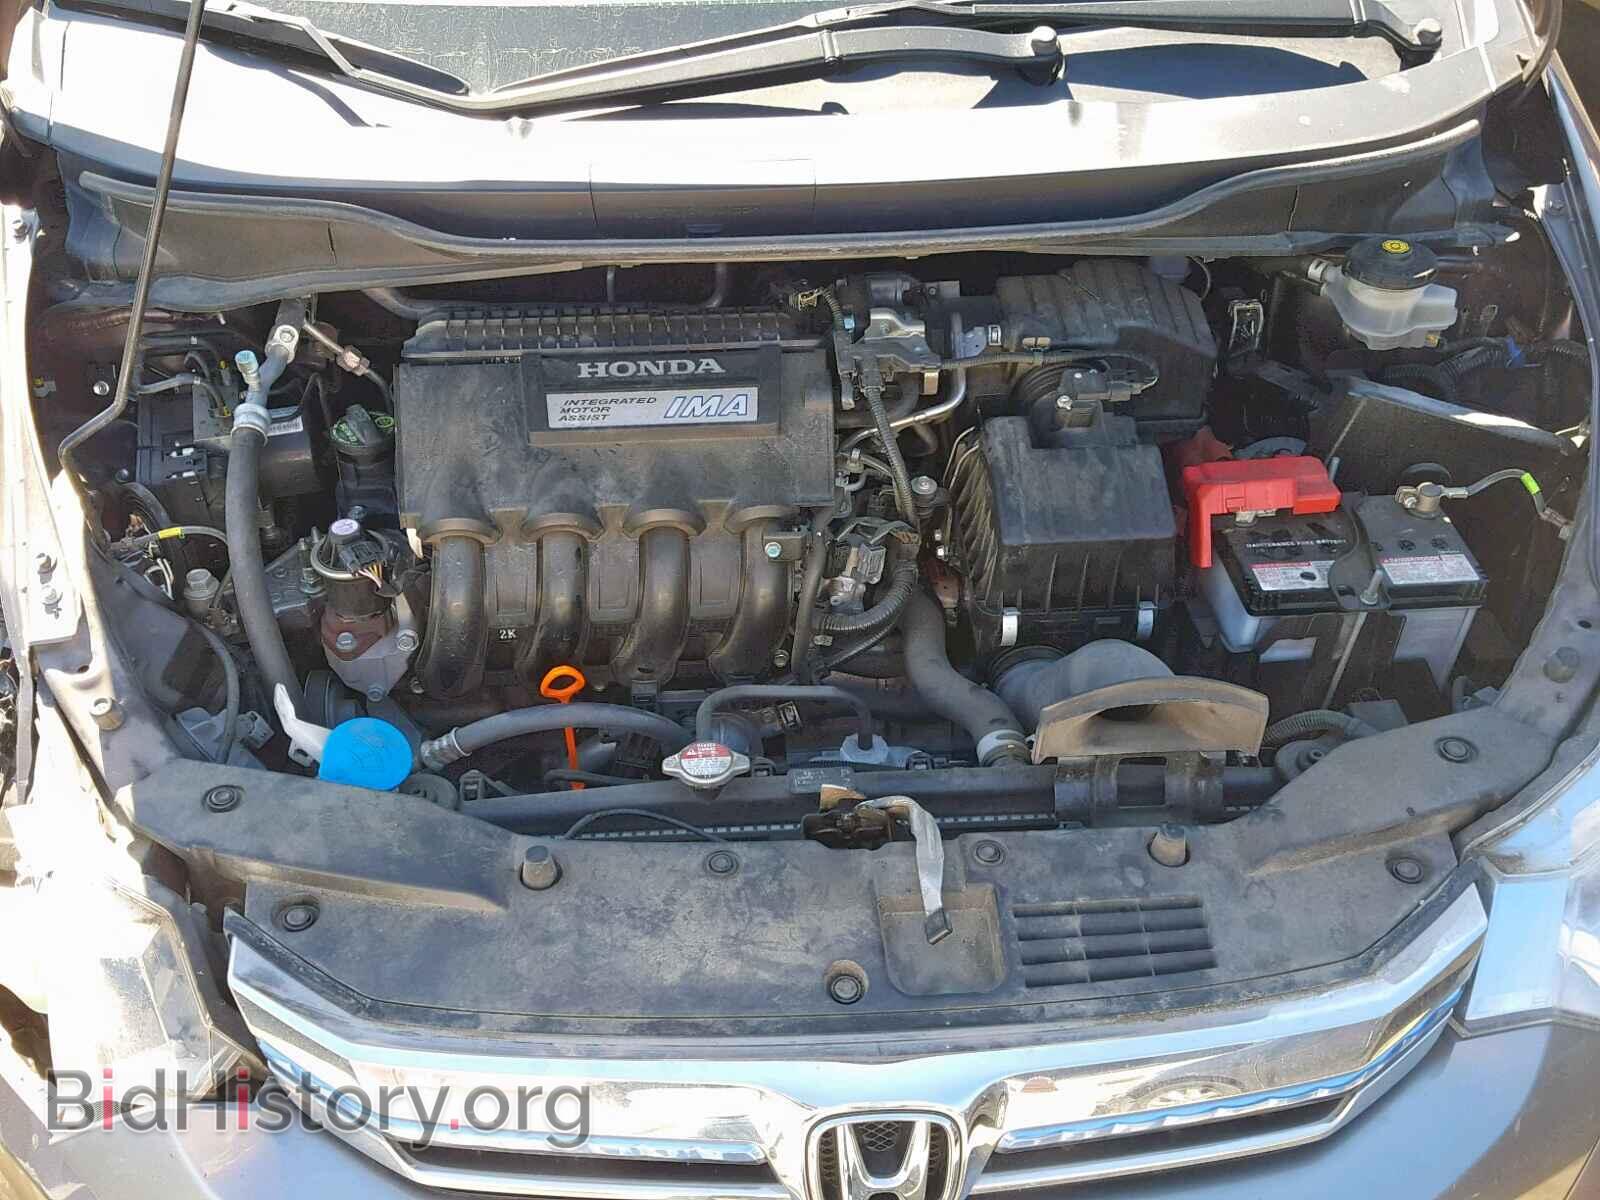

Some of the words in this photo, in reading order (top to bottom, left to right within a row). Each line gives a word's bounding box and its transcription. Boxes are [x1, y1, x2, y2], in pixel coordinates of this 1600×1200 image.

[577, 358, 726, 378] HONDA
[564, 396, 657, 406] INTEGRATED
[559, 406, 612, 414] MOTOR
[664, 394, 749, 419] IMA
[558, 414, 610, 422] ASSIST
[499, 629, 517, 639] 2K
